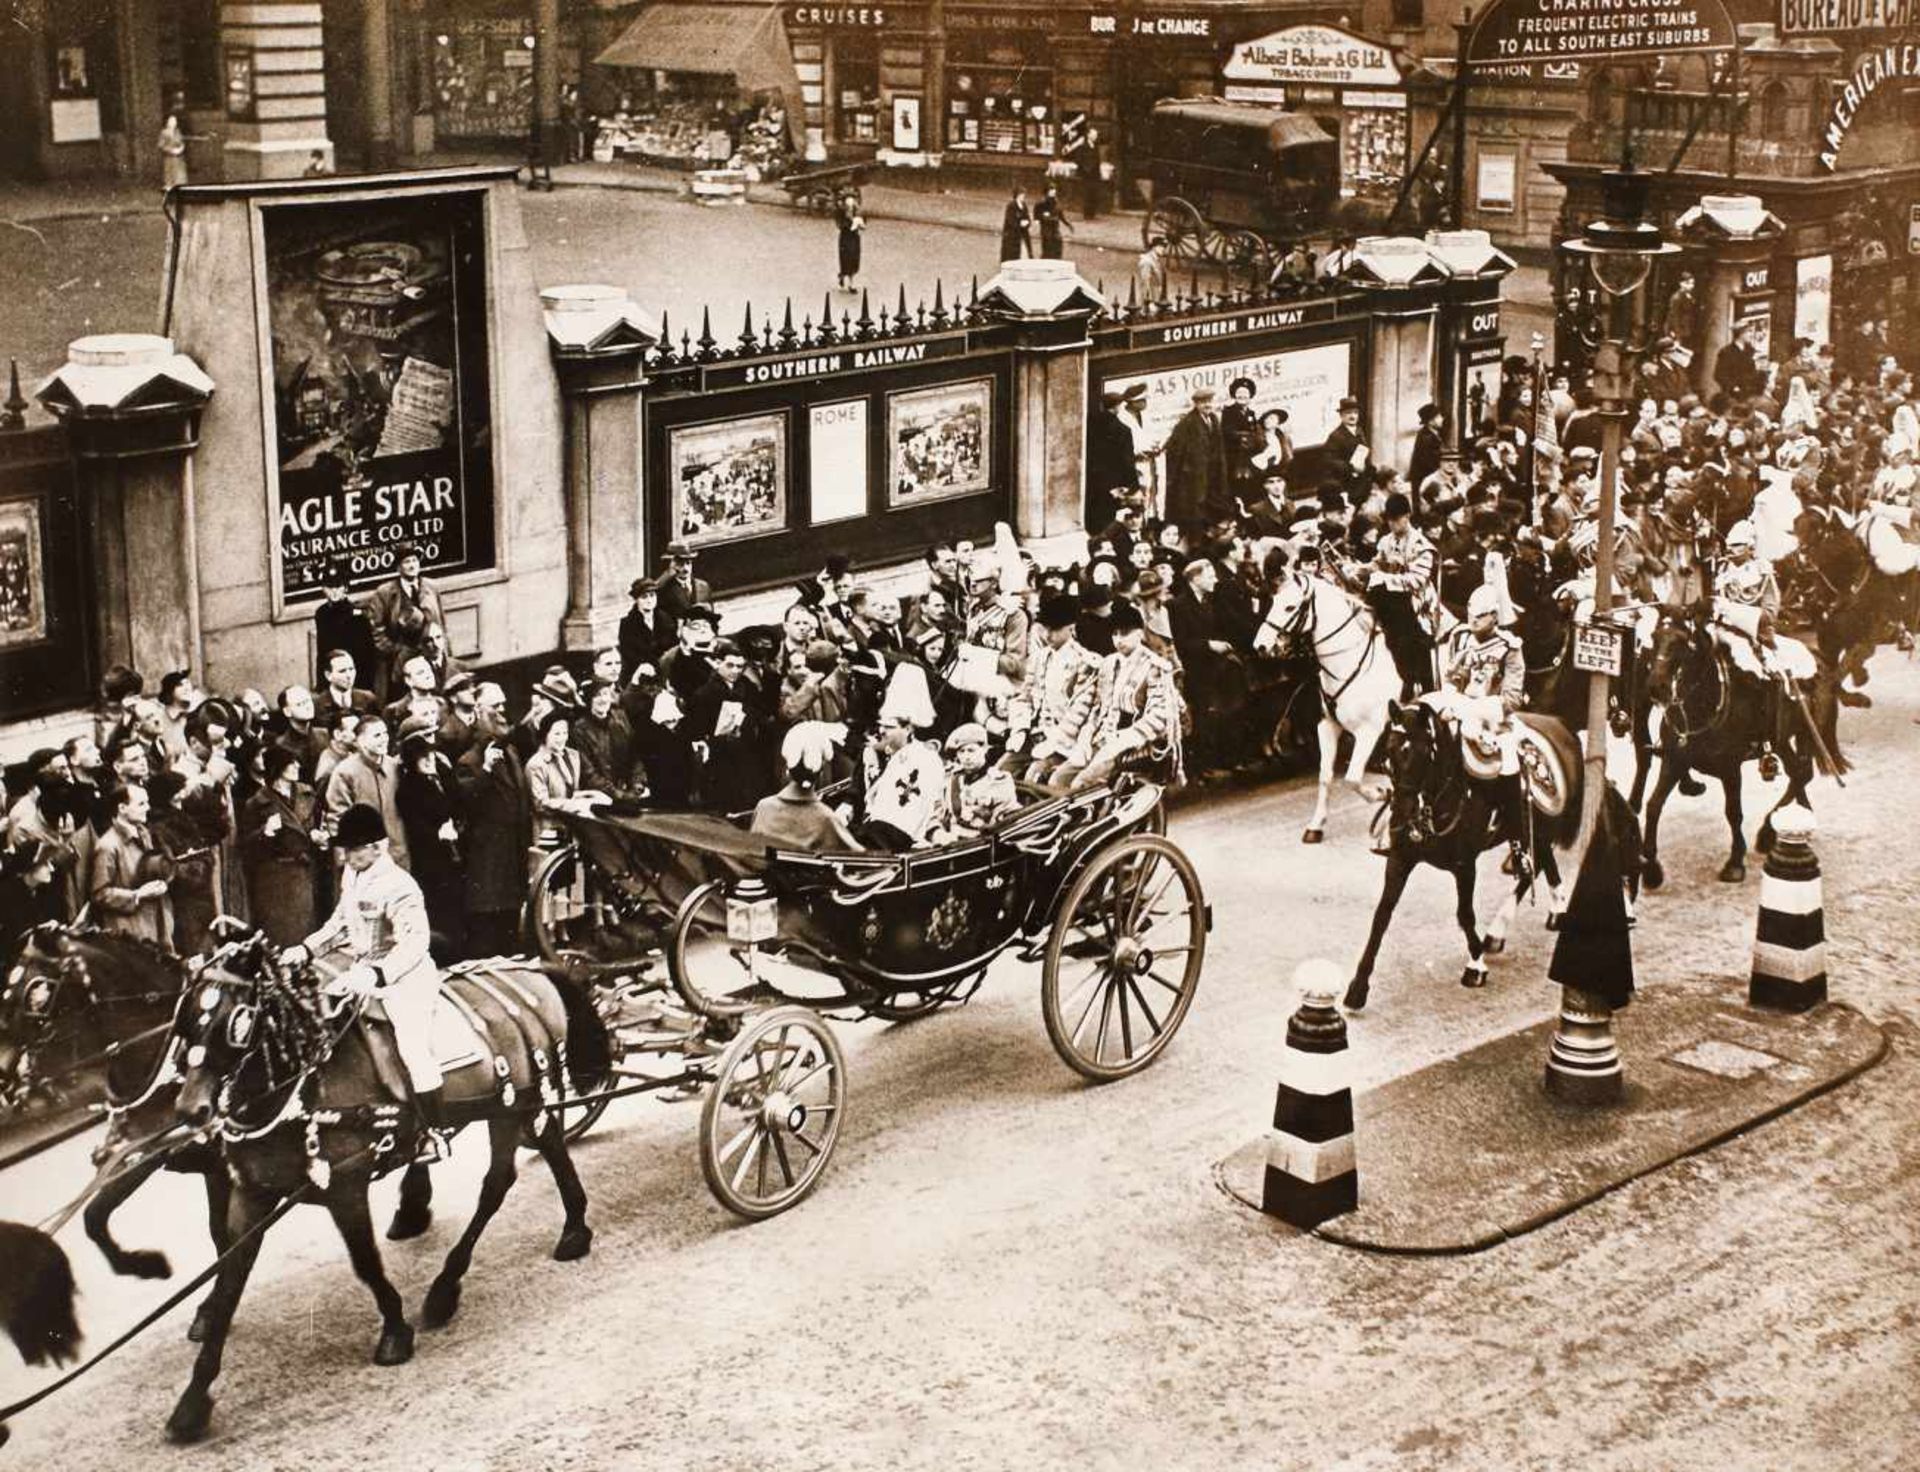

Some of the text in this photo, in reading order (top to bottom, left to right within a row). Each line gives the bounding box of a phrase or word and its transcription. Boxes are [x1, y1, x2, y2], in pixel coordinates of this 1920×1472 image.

[795, 8, 884, 25] CRUISES
[1157, 18, 1209, 36] CHANGE
[1518, 10, 1697, 34] FREQUENT ELECTRIC TRAINS
[1498, 27, 1710, 54] TO ALL SOUTH EAST SUBURBS
[1821, 46, 1897, 172] AMERICAN
[1745, 269, 1769, 287] OUT
[1163, 309, 1304, 343] SOUTHERN RAILWAY
[1472, 312, 1499, 332] OUT
[745, 344, 927, 384] SOUTHERN RAILWAY
[1154, 359, 1282, 396] AS YOU PLEASE
[814, 405, 857, 427] ROME
[374, 476, 455, 522] STAR
[1579, 631, 1618, 648] KEEP
[1577, 653, 1618, 670] LEFT
